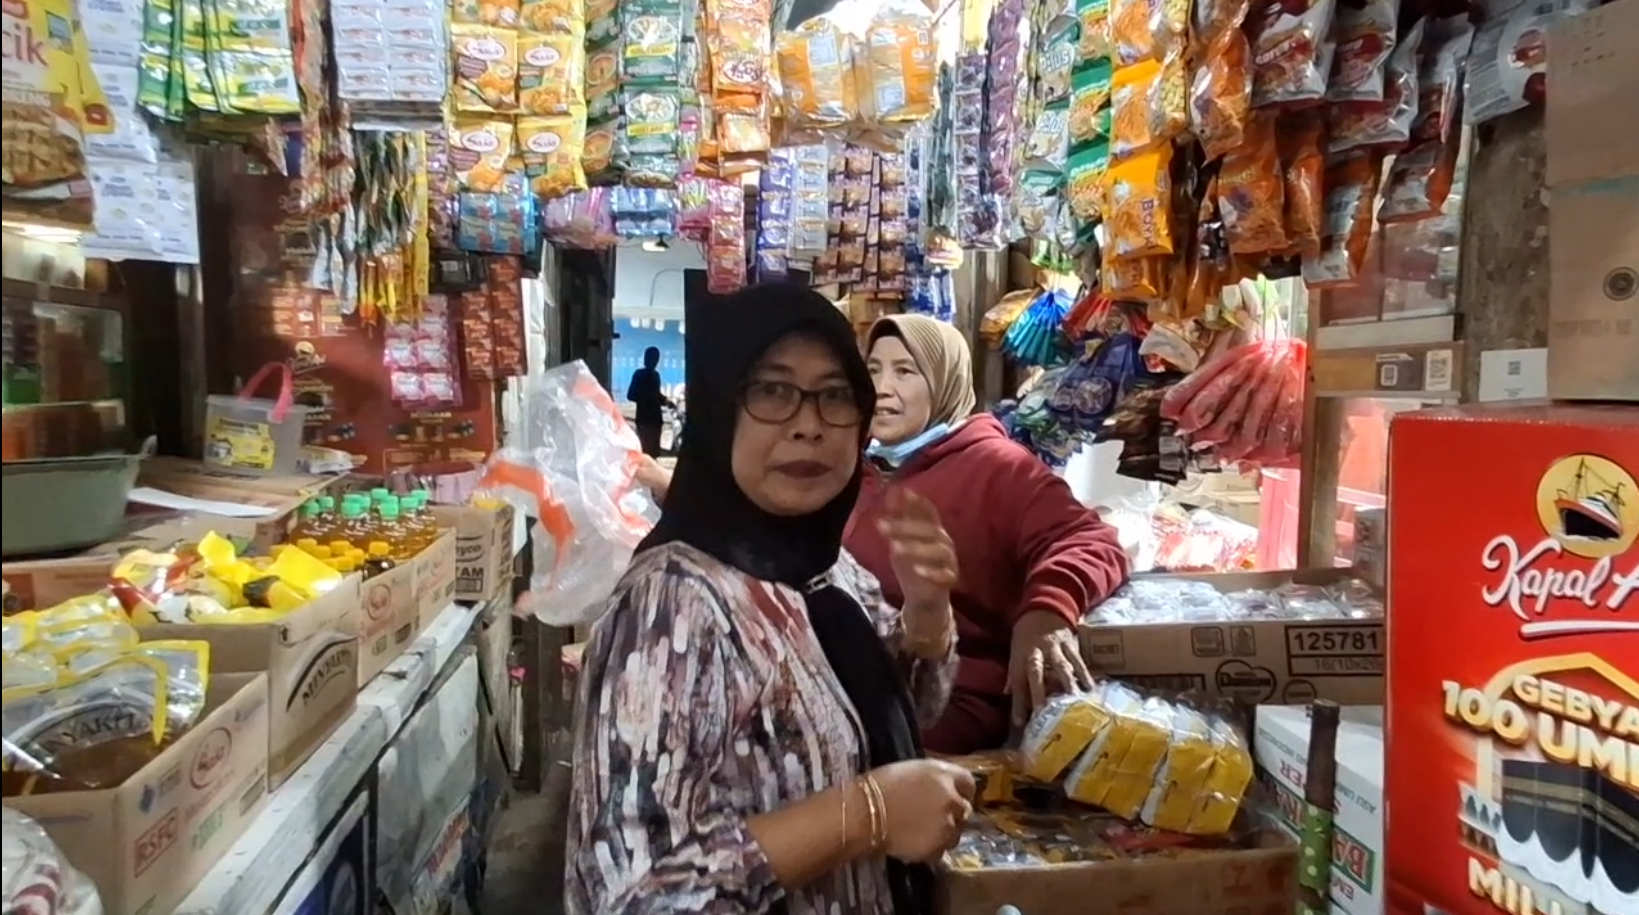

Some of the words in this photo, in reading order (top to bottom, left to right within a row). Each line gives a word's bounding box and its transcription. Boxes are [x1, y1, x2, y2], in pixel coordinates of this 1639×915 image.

[1482, 534, 1611, 621] Kapal
[1294, 630, 1379, 651] 125781
[1442, 679, 1530, 744] 100
